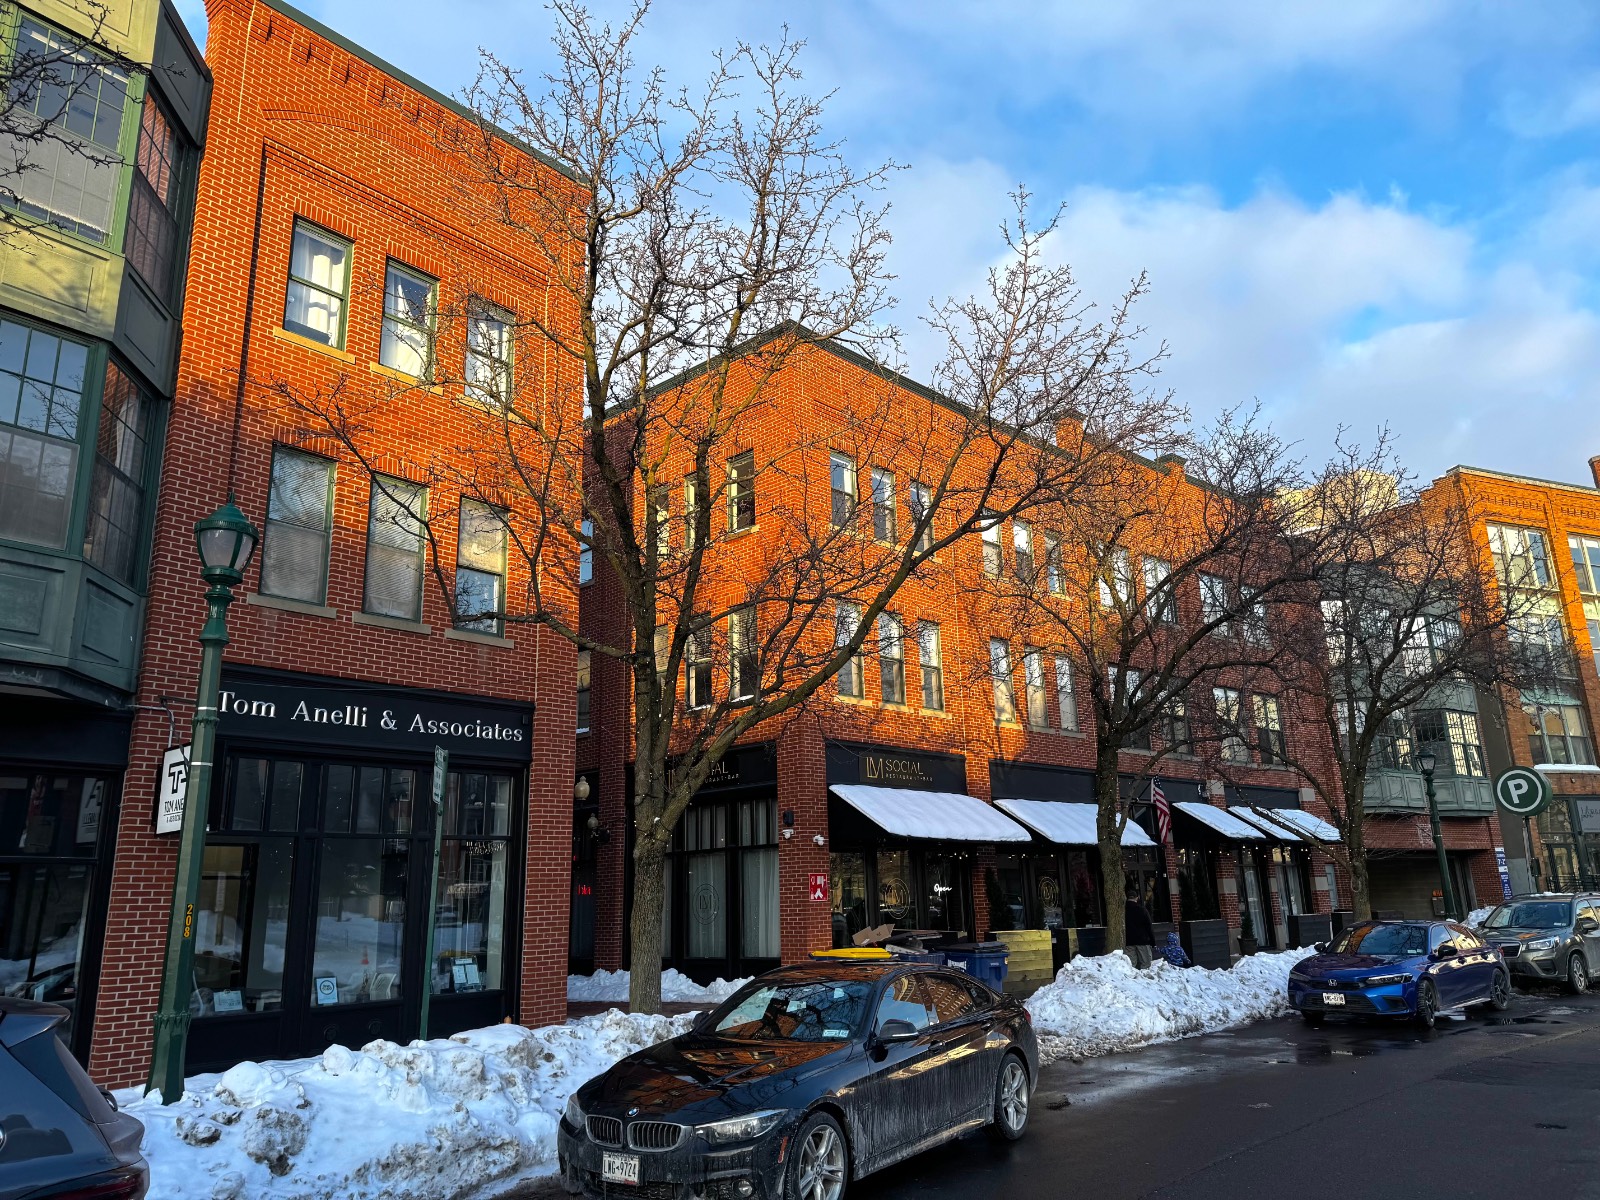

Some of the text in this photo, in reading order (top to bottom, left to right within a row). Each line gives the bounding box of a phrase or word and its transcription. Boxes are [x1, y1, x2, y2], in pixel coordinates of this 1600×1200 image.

[218, 690, 523, 742] Tom Anelli & Associates
[885, 759, 924, 775] SOCIAL
[1507, 778, 1529, 804] P
[933, 883, 952, 897] Open
[184, 904, 193, 938] 208
